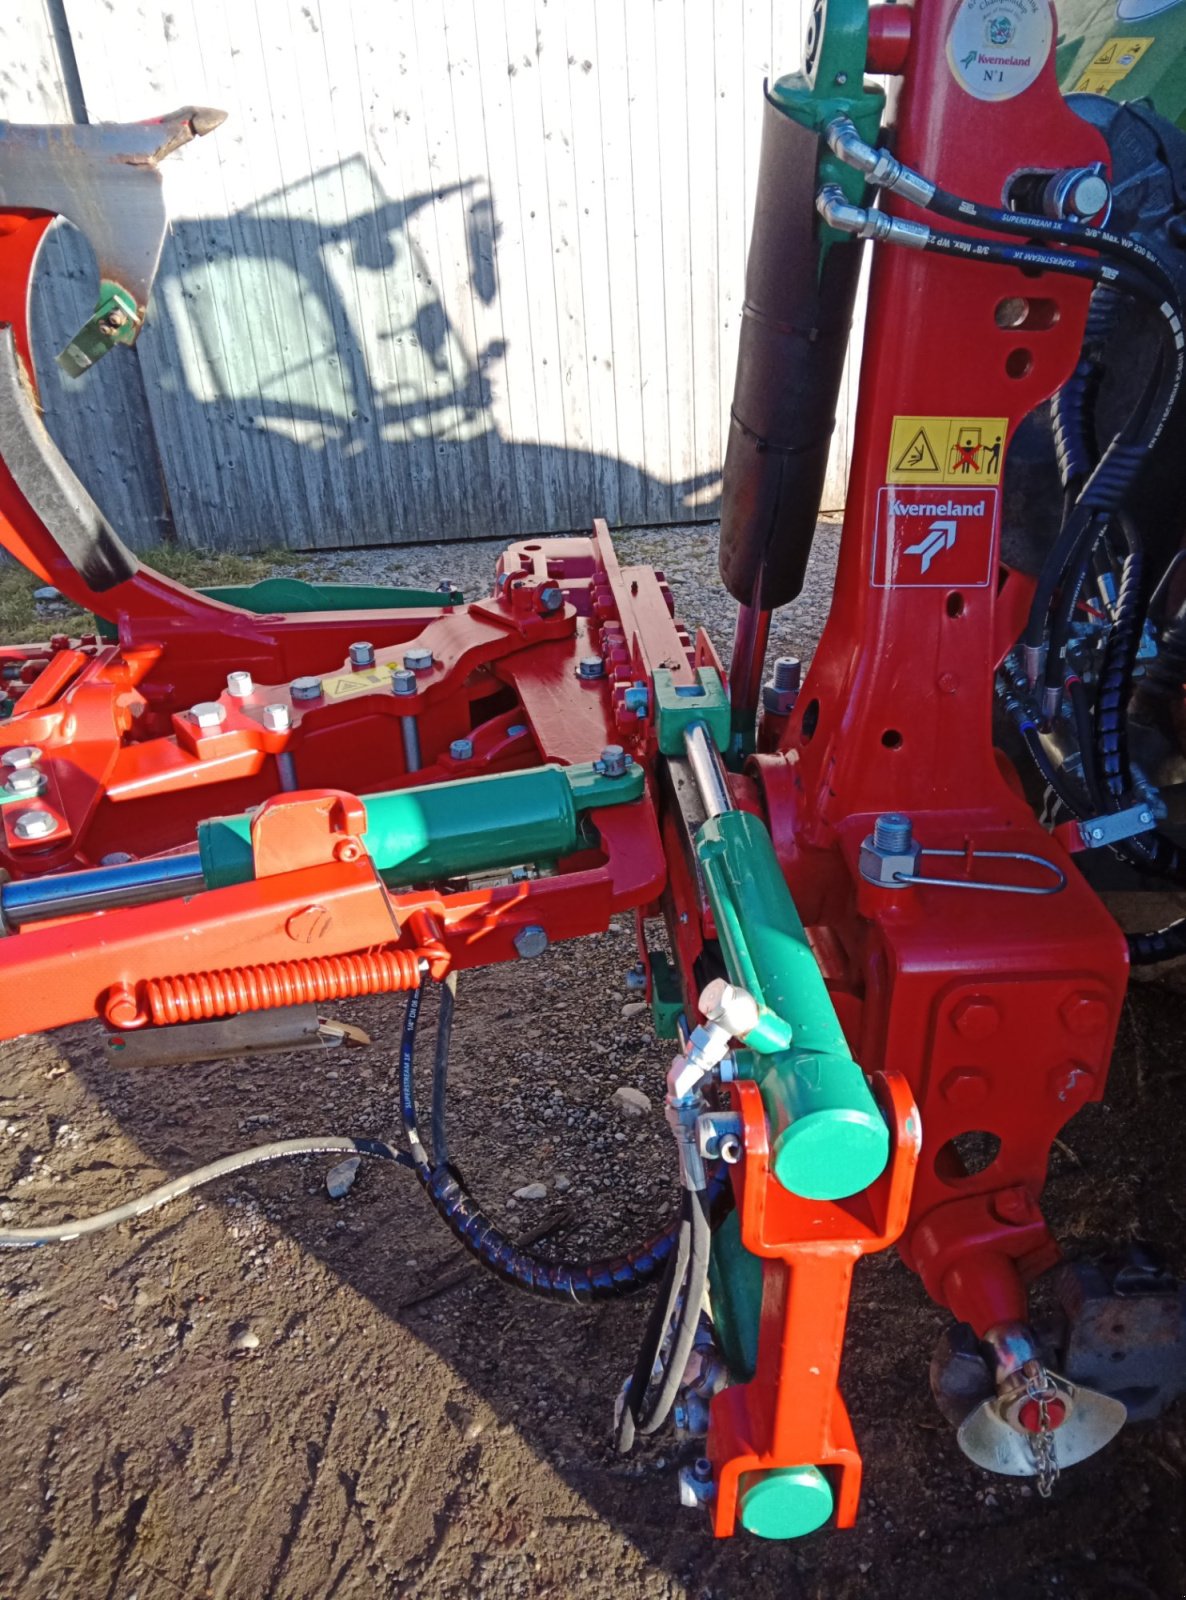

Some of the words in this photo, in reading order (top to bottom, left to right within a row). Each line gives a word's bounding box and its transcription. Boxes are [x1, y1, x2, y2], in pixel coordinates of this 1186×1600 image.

[978, 54, 1031, 66] Kverneland
[1002, 213, 1052, 228] SUPERSTREAM
[1053, 222, 1062, 230] 1K
[1102, 232, 1119, 244] Max.
[1121, 237, 1134, 248] WP
[1133, 244, 1146, 255] 230
[936, 237, 950, 248] WP
[953, 240, 971, 252] Max.
[1024, 254, 1076, 268] SUPERSTREAM
[888, 500, 985, 517] Kverneland
[403, 1062, 412, 1109] SUPERSTREAM
[409, 1008, 417, 1018] DN
